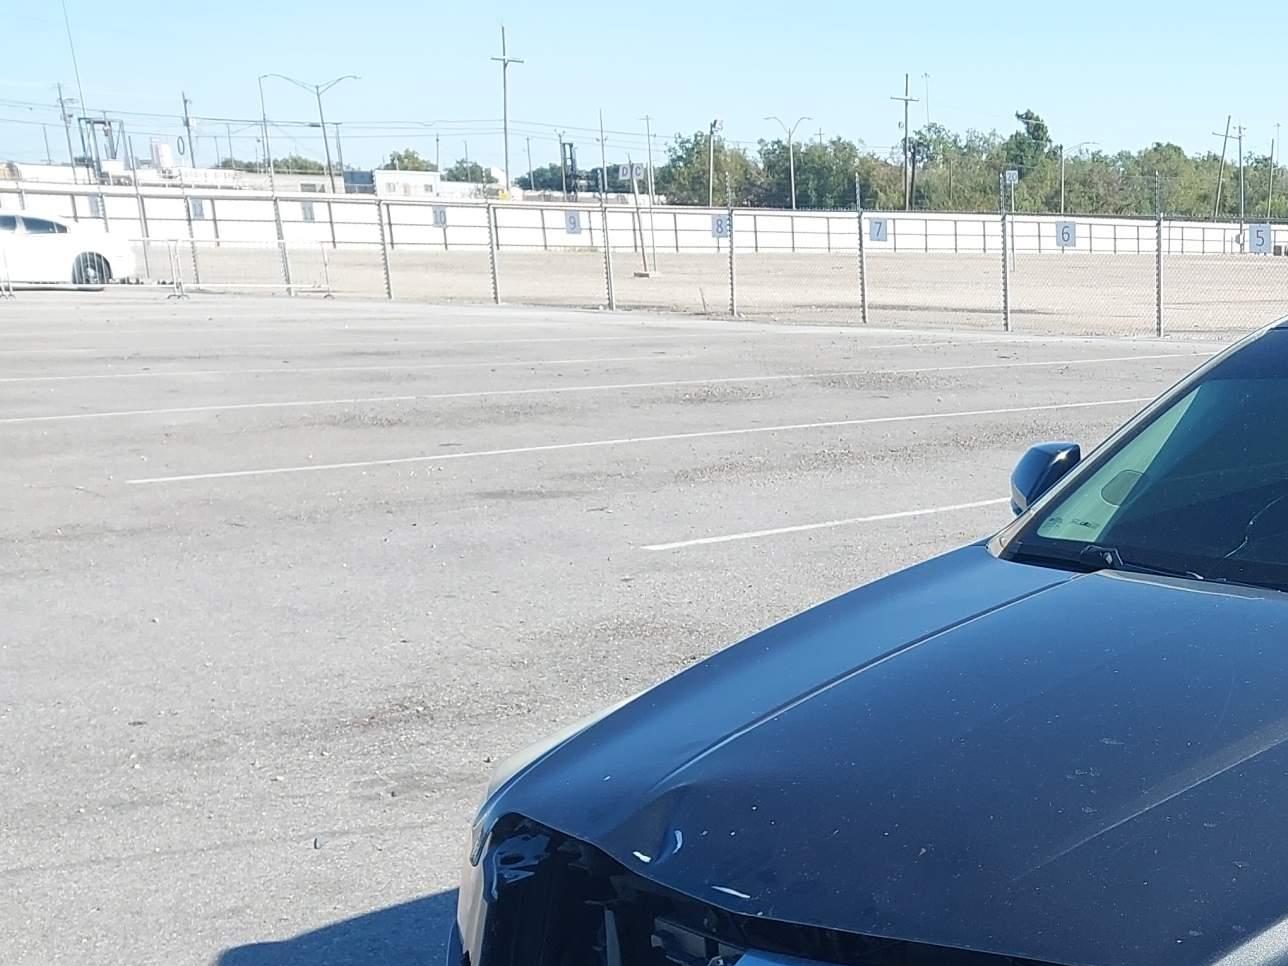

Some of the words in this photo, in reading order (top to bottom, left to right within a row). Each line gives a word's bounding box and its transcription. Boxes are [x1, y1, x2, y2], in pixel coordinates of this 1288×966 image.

[621, 166, 629, 177] D
[634, 166, 642, 177] C
[432, 209, 447, 225] 10
[568, 215, 577, 230] 9
[716, 218, 723, 234] 8
[874, 221, 883, 238] 7
[1060, 225, 1070, 242] 6
[1255, 229, 1265, 247] 5
